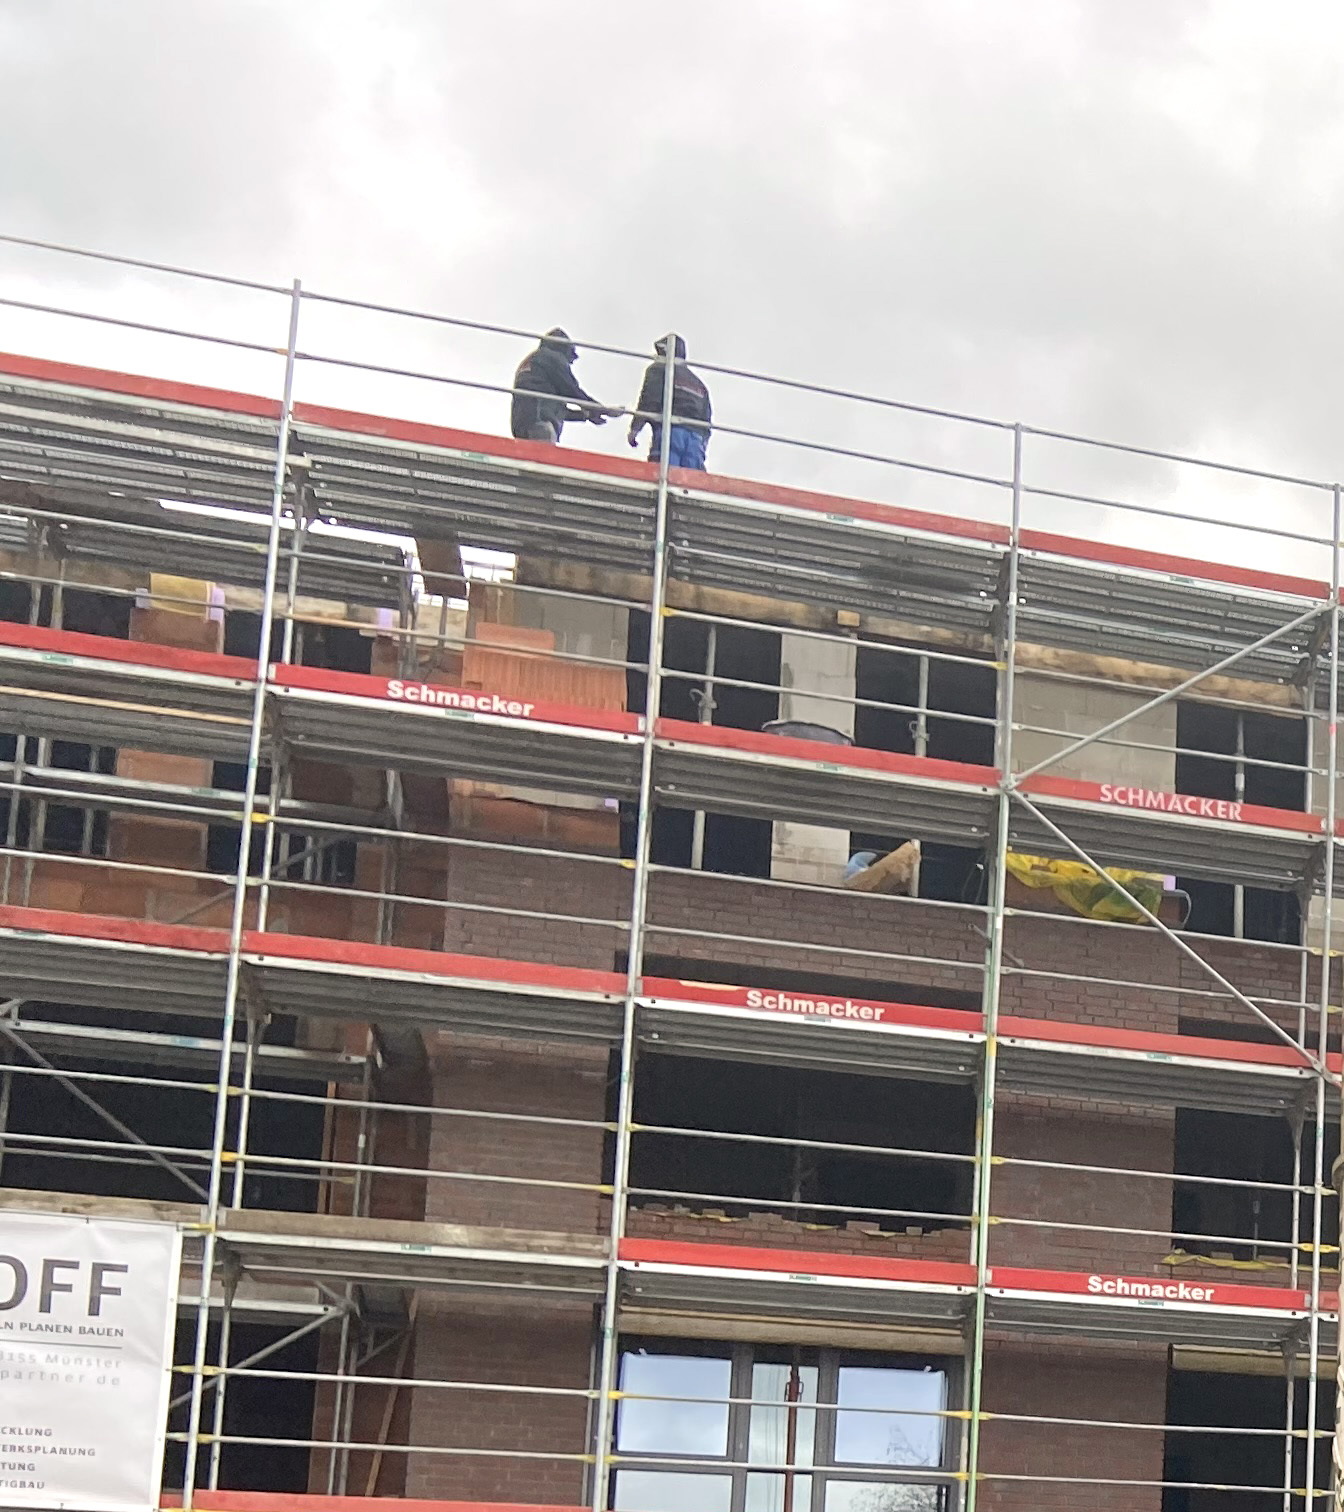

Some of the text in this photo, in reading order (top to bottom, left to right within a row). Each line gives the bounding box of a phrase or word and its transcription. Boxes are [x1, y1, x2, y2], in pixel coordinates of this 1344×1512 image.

[387, 680, 535, 716] Schmacker
[1100, 784, 1242, 821] SCHMACKER
[746, 989, 885, 1021] Schmacker
[1087, 1275, 1215, 1301] Schmacker
[20, 1322, 72, 1334] PLANEN
[79, 1326, 124, 1337] BAUEN
